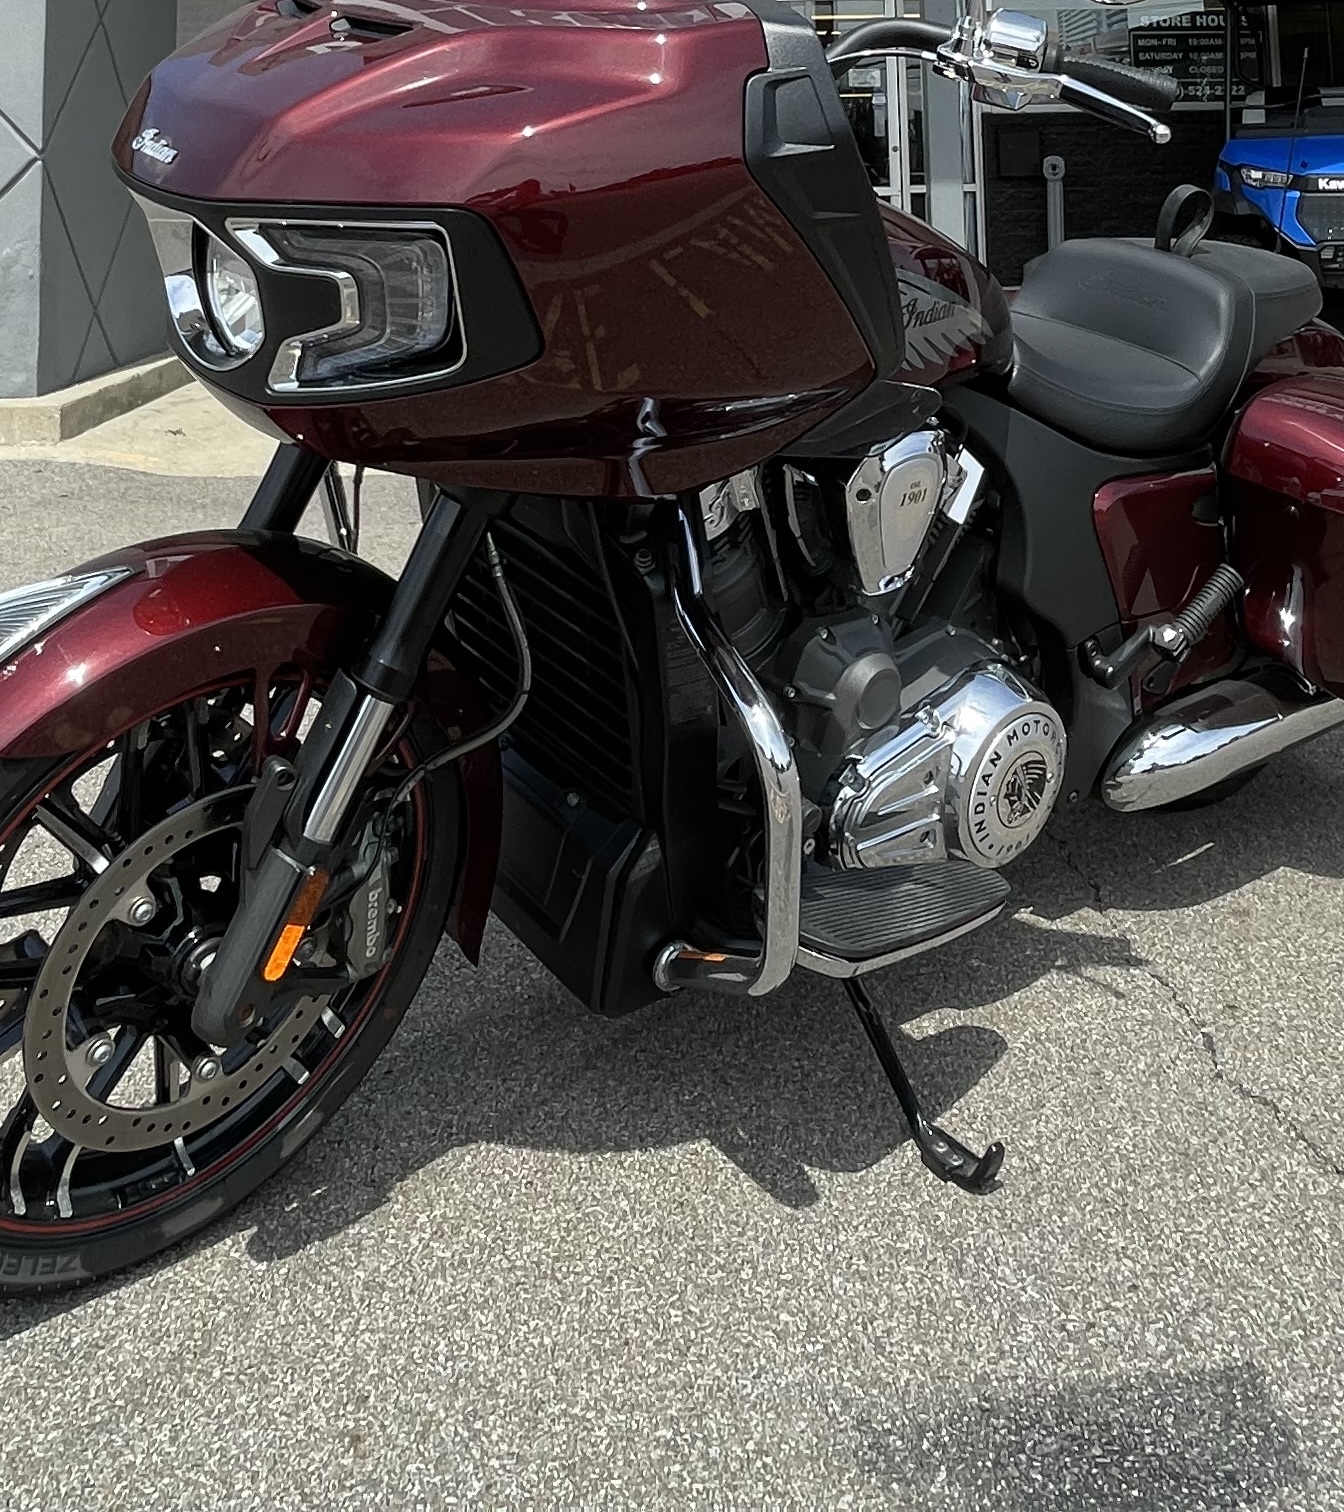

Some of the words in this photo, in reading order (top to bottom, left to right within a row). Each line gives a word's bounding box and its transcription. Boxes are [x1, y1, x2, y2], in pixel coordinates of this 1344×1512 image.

[1139, 15, 1192, 28] STORE
[902, 297, 955, 328] Indian
[899, 487, 927, 507] 1901
[974, 750, 1003, 843] INDIAN
[365, 887, 383, 958] brembo
